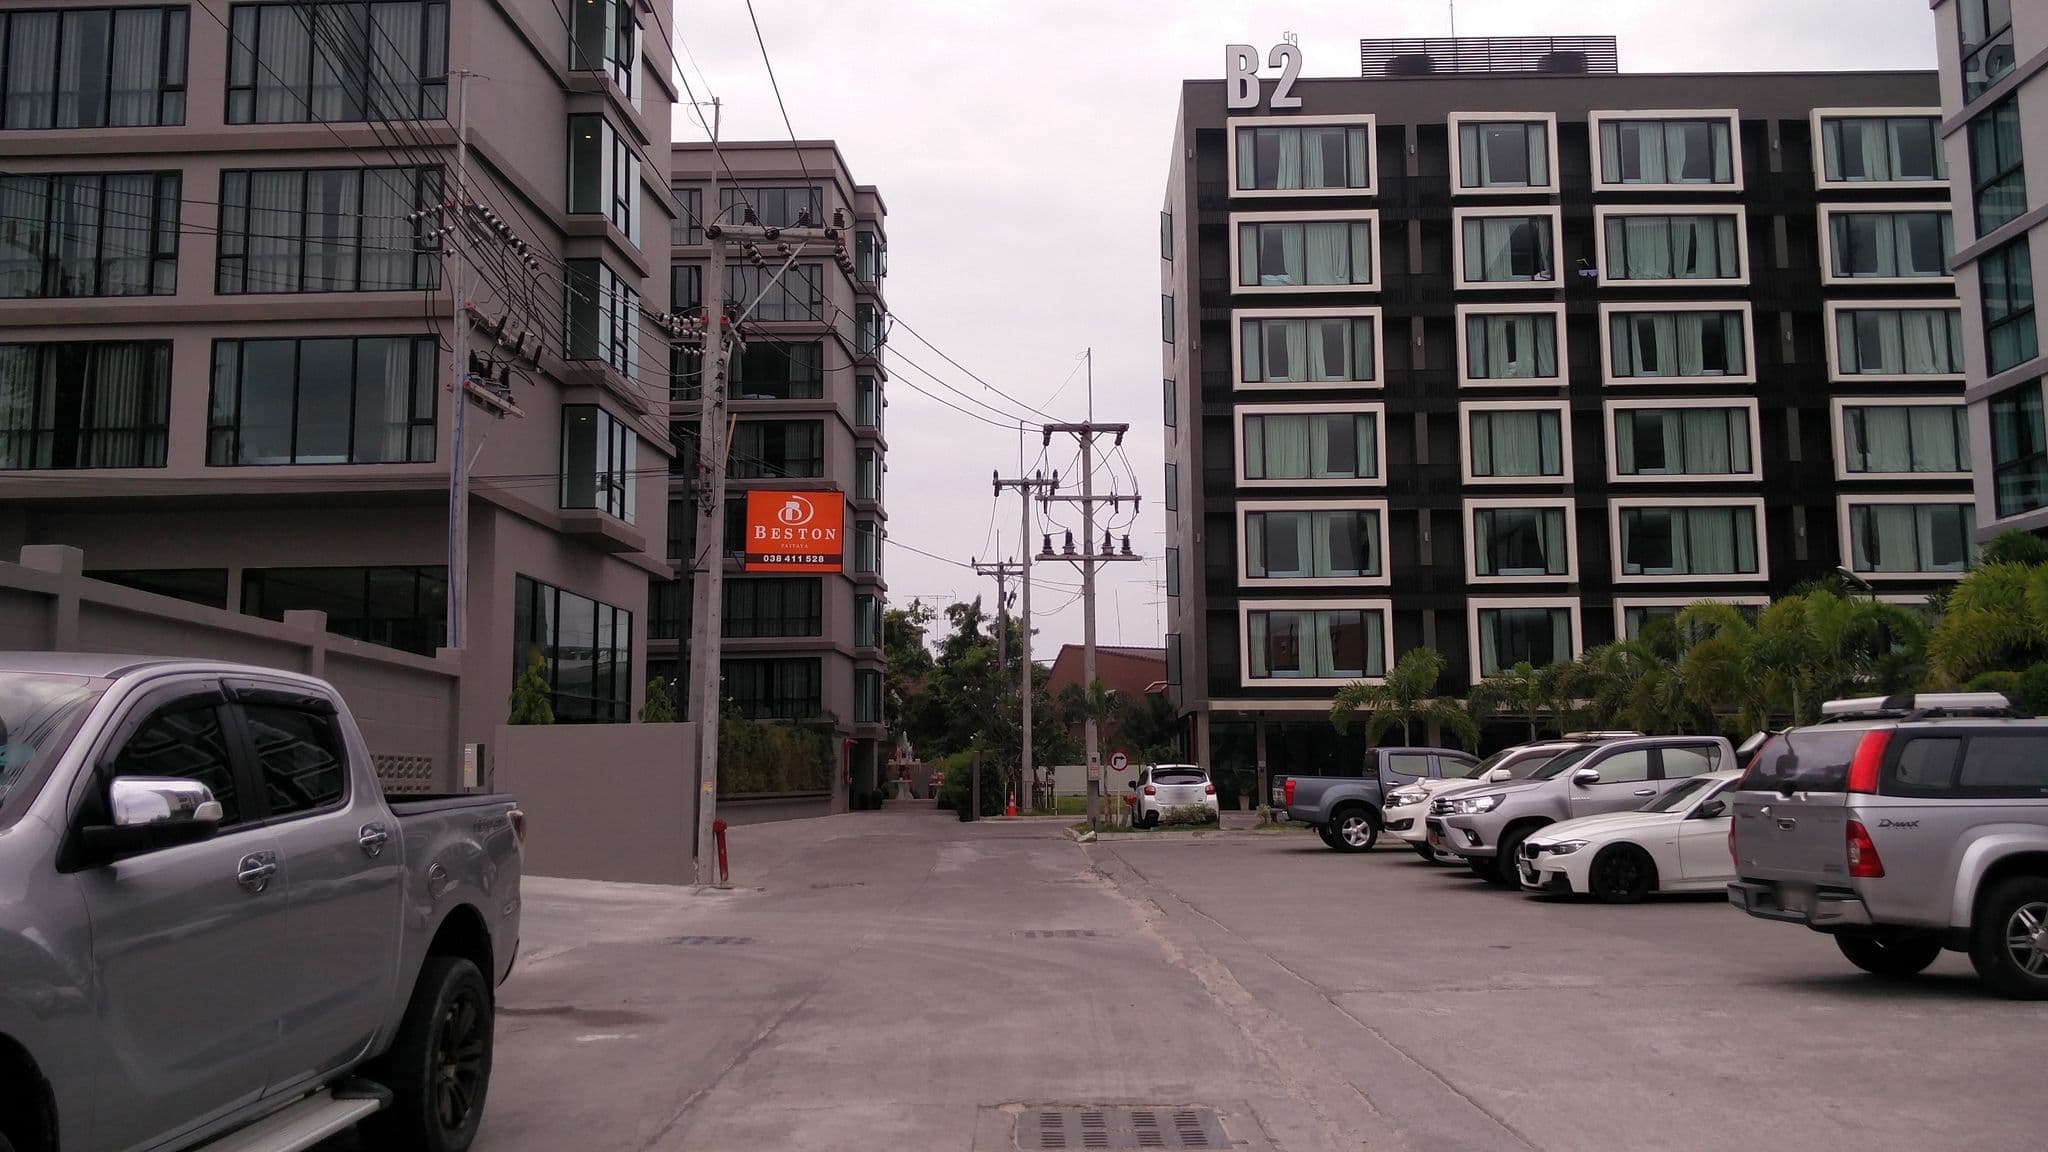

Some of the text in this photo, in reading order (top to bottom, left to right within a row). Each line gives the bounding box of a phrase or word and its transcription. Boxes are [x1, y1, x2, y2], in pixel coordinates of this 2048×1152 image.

[1226, 43, 1302, 109] B2
[754, 525, 836, 540] BESTON
[763, 554, 824, 563] 038 411 528
